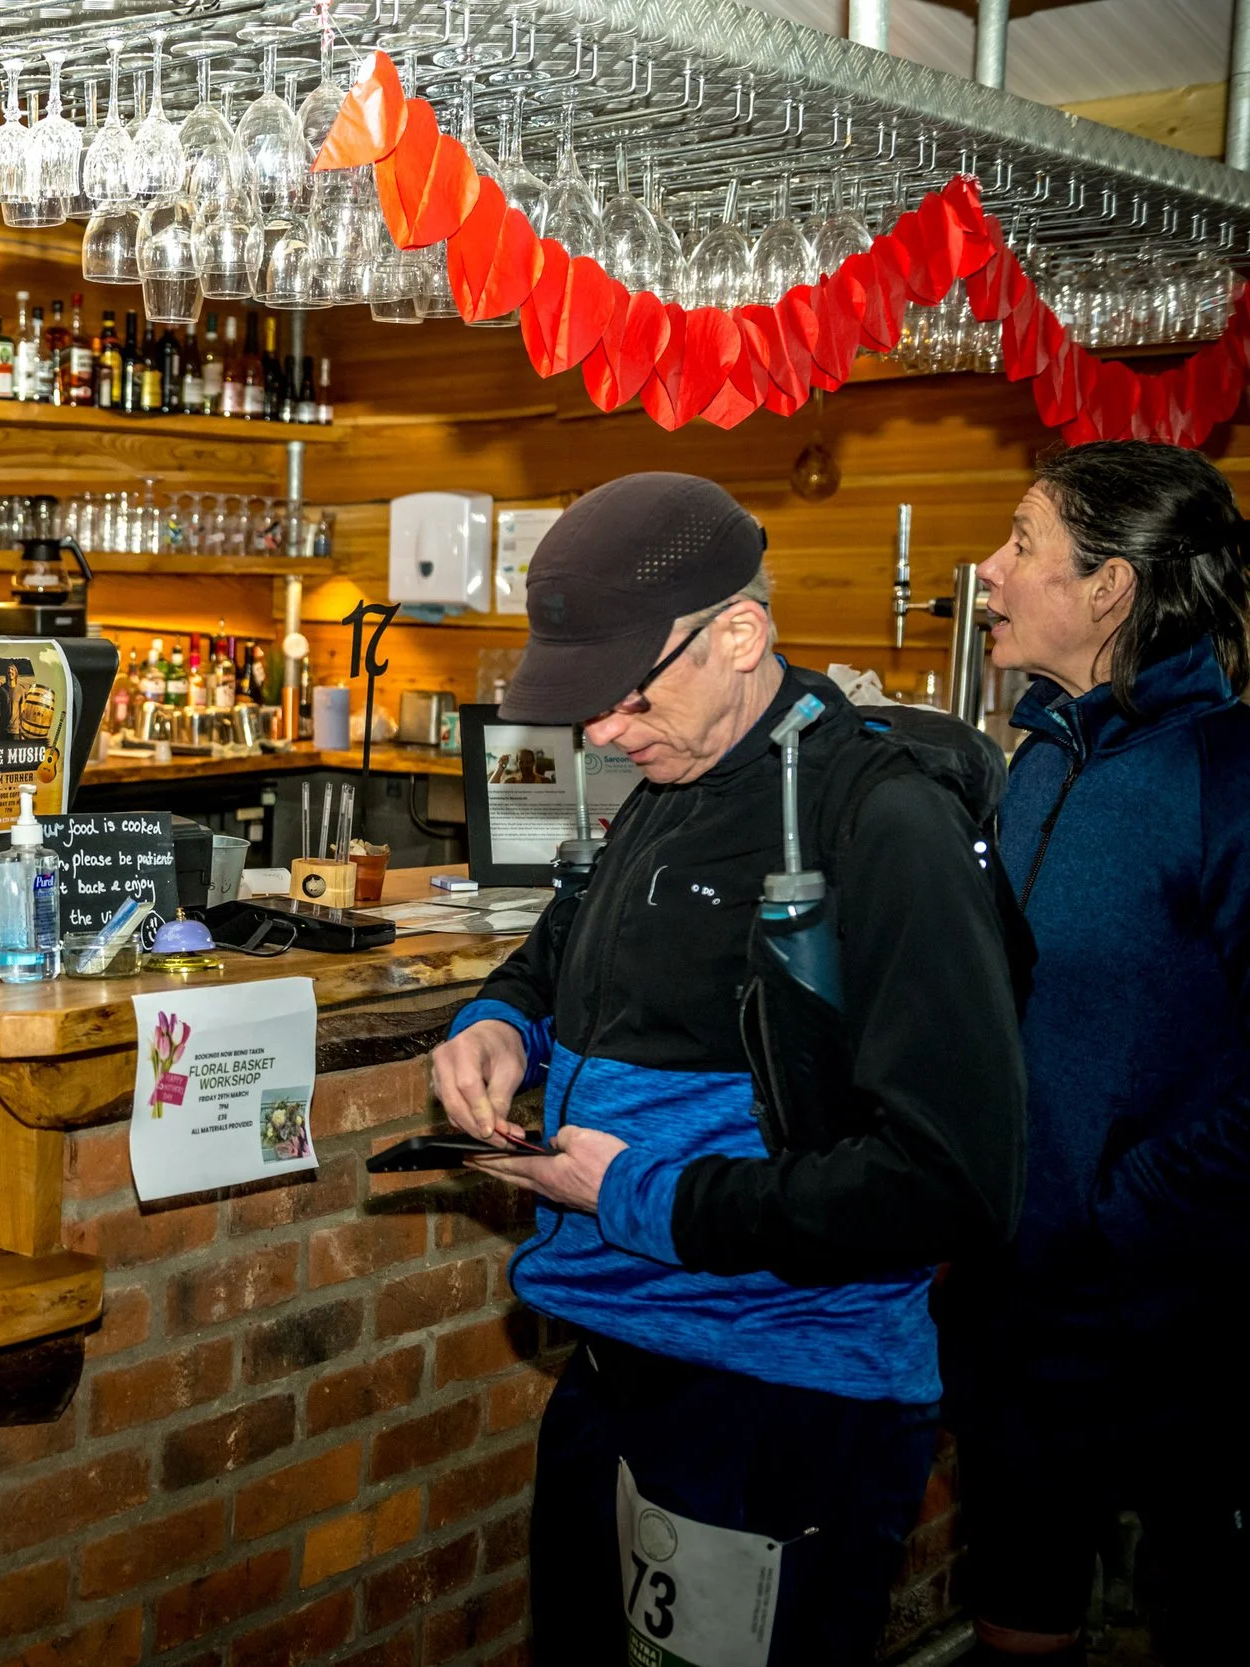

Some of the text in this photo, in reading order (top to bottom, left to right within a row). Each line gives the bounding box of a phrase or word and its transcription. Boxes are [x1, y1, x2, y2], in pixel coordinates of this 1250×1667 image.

[7, 746, 46, 764] MUSIC
[5, 773, 33, 784] TURNER
[63, 818, 99, 848] food
[103, 817, 115, 833] is
[121, 817, 162, 835] cooked
[72, 849, 112, 879] please
[119, 851, 132, 866] be
[137, 851, 174, 870] patient
[78, 879, 106, 894] back
[124, 874, 156, 908] enjoy
[69, 909, 92, 926] the
[194, 1051, 220, 1061] BOOKINGS
[221, 1050, 233, 1058] NOW
[234, 1049, 248, 1057] BEING
[189, 1057, 276, 1078] FLORAL BASKET
[199, 1072, 261, 1090] WORKSHOP
[198, 1095, 217, 1103] FRIDAY
[231, 1090, 250, 1099] MARCH
[218, 1103, 229, 1111] 7PM
[201, 1124, 228, 1135] MATERIALS
[228, 1120, 253, 1130] PROVIDED
